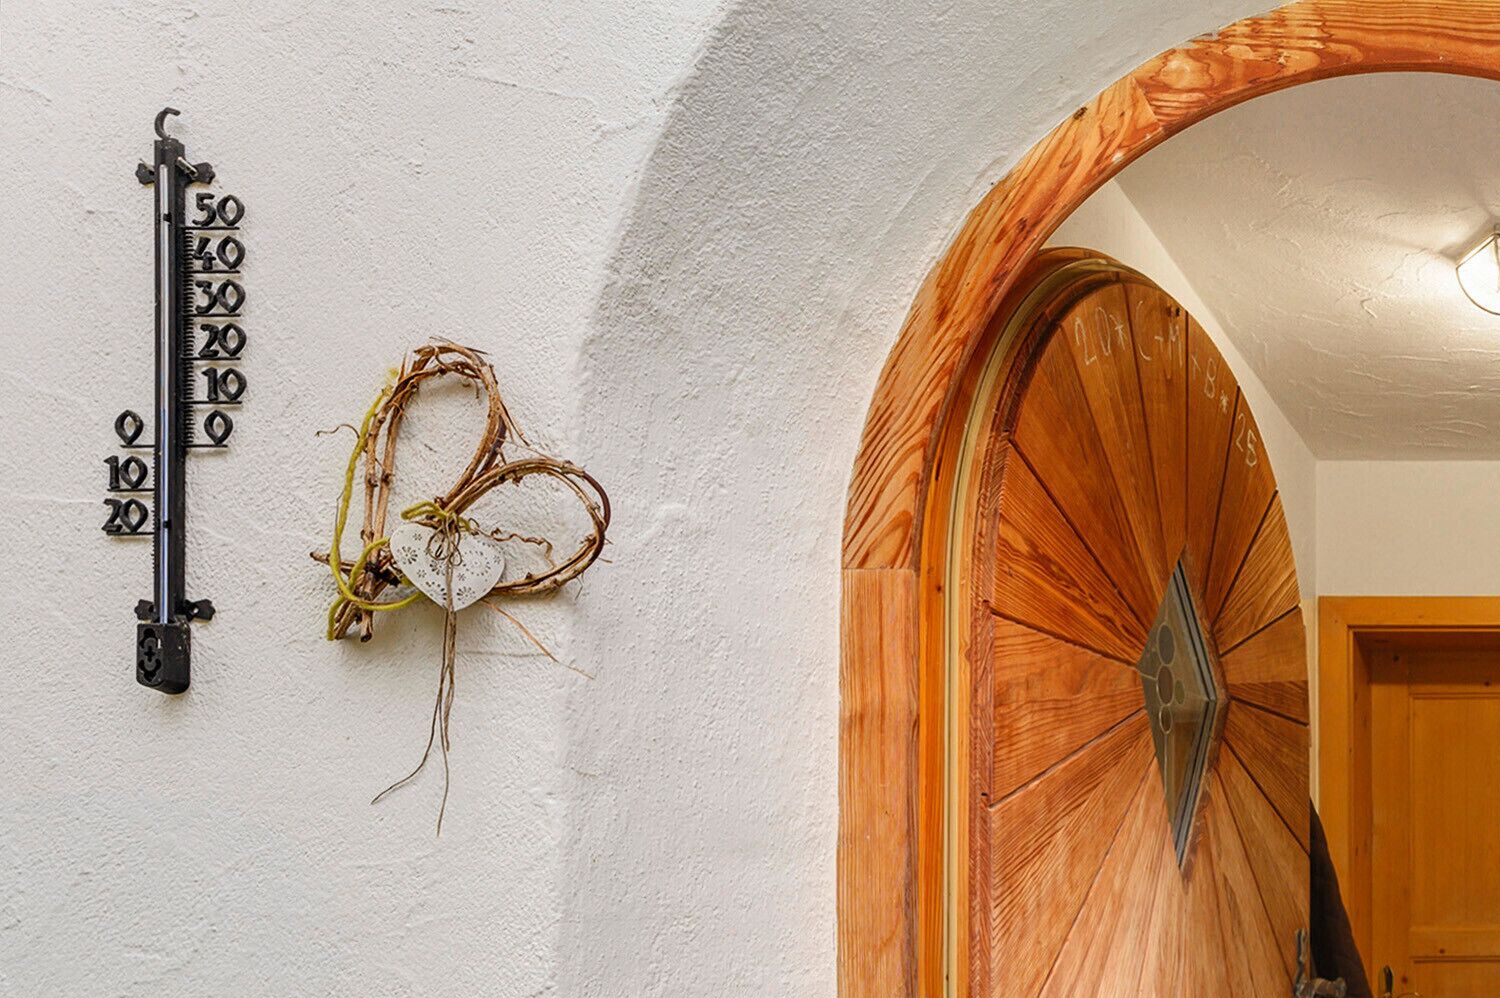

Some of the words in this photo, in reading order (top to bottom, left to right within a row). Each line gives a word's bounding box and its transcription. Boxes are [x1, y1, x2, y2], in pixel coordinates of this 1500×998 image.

[194, 193, 245, 228] 50
[193, 235, 246, 270] 40
[195, 279, 246, 314] 30
[199, 323, 247, 359] 20
[202, 367, 247, 402] 10
[114, 409, 144, 445] 0
[203, 410, 234, 445] 0
[103, 455, 149, 490] 10
[101, 498, 149, 533] 20
